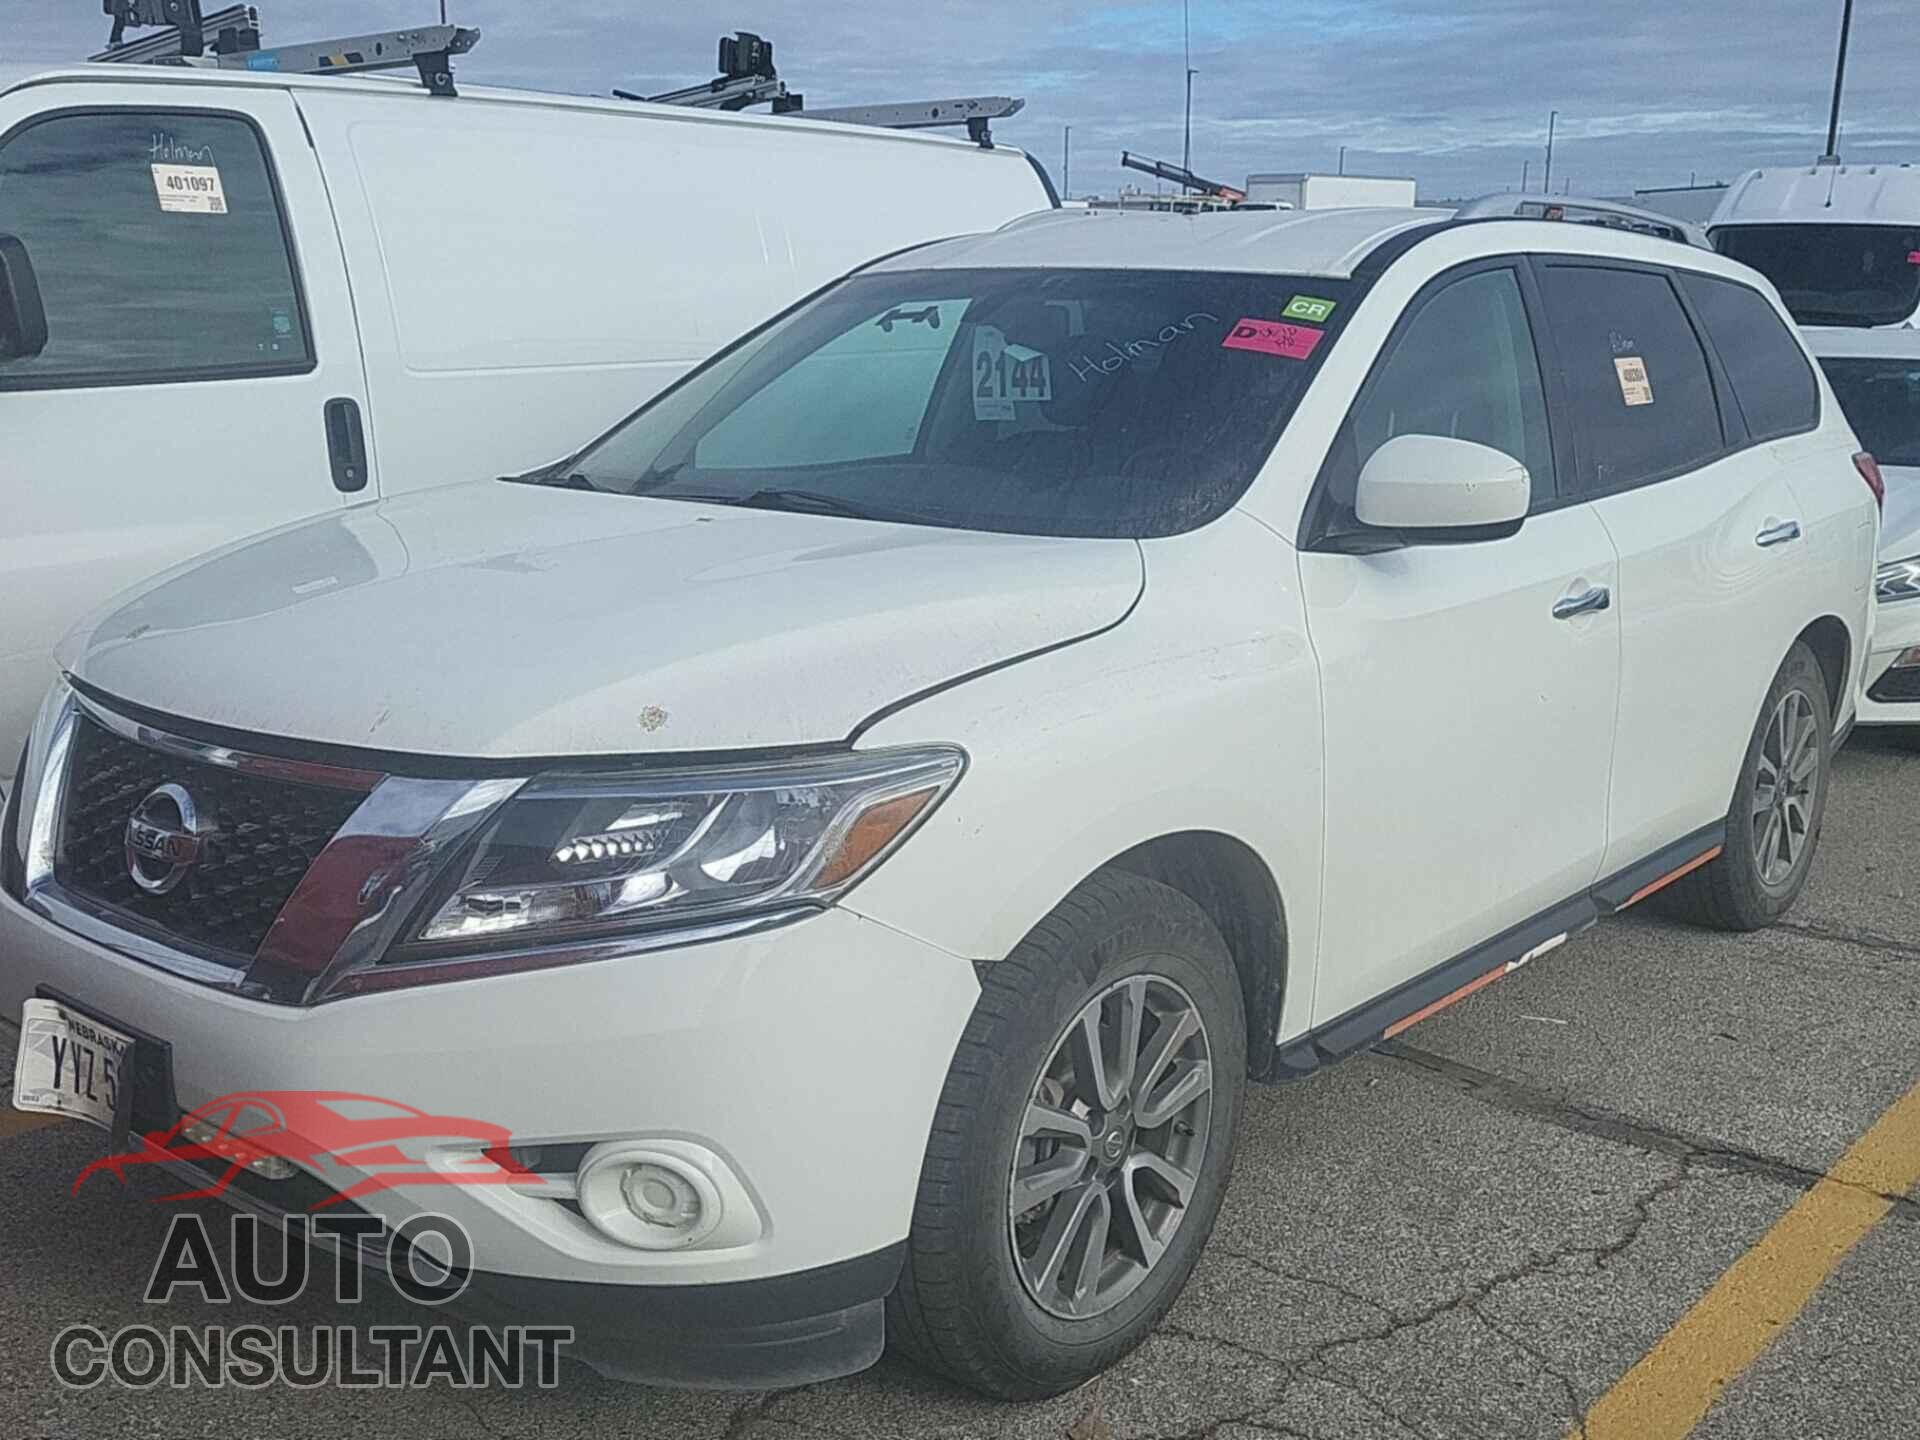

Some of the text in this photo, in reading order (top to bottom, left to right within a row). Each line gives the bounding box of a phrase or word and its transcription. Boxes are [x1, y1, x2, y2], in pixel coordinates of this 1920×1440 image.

[166, 175, 215, 191] 401097
[1291, 301, 1326, 316] CR
[1232, 326, 1258, 338] D
[1068, 312, 1219, 383] Holman
[976, 351, 1047, 397] 2144
